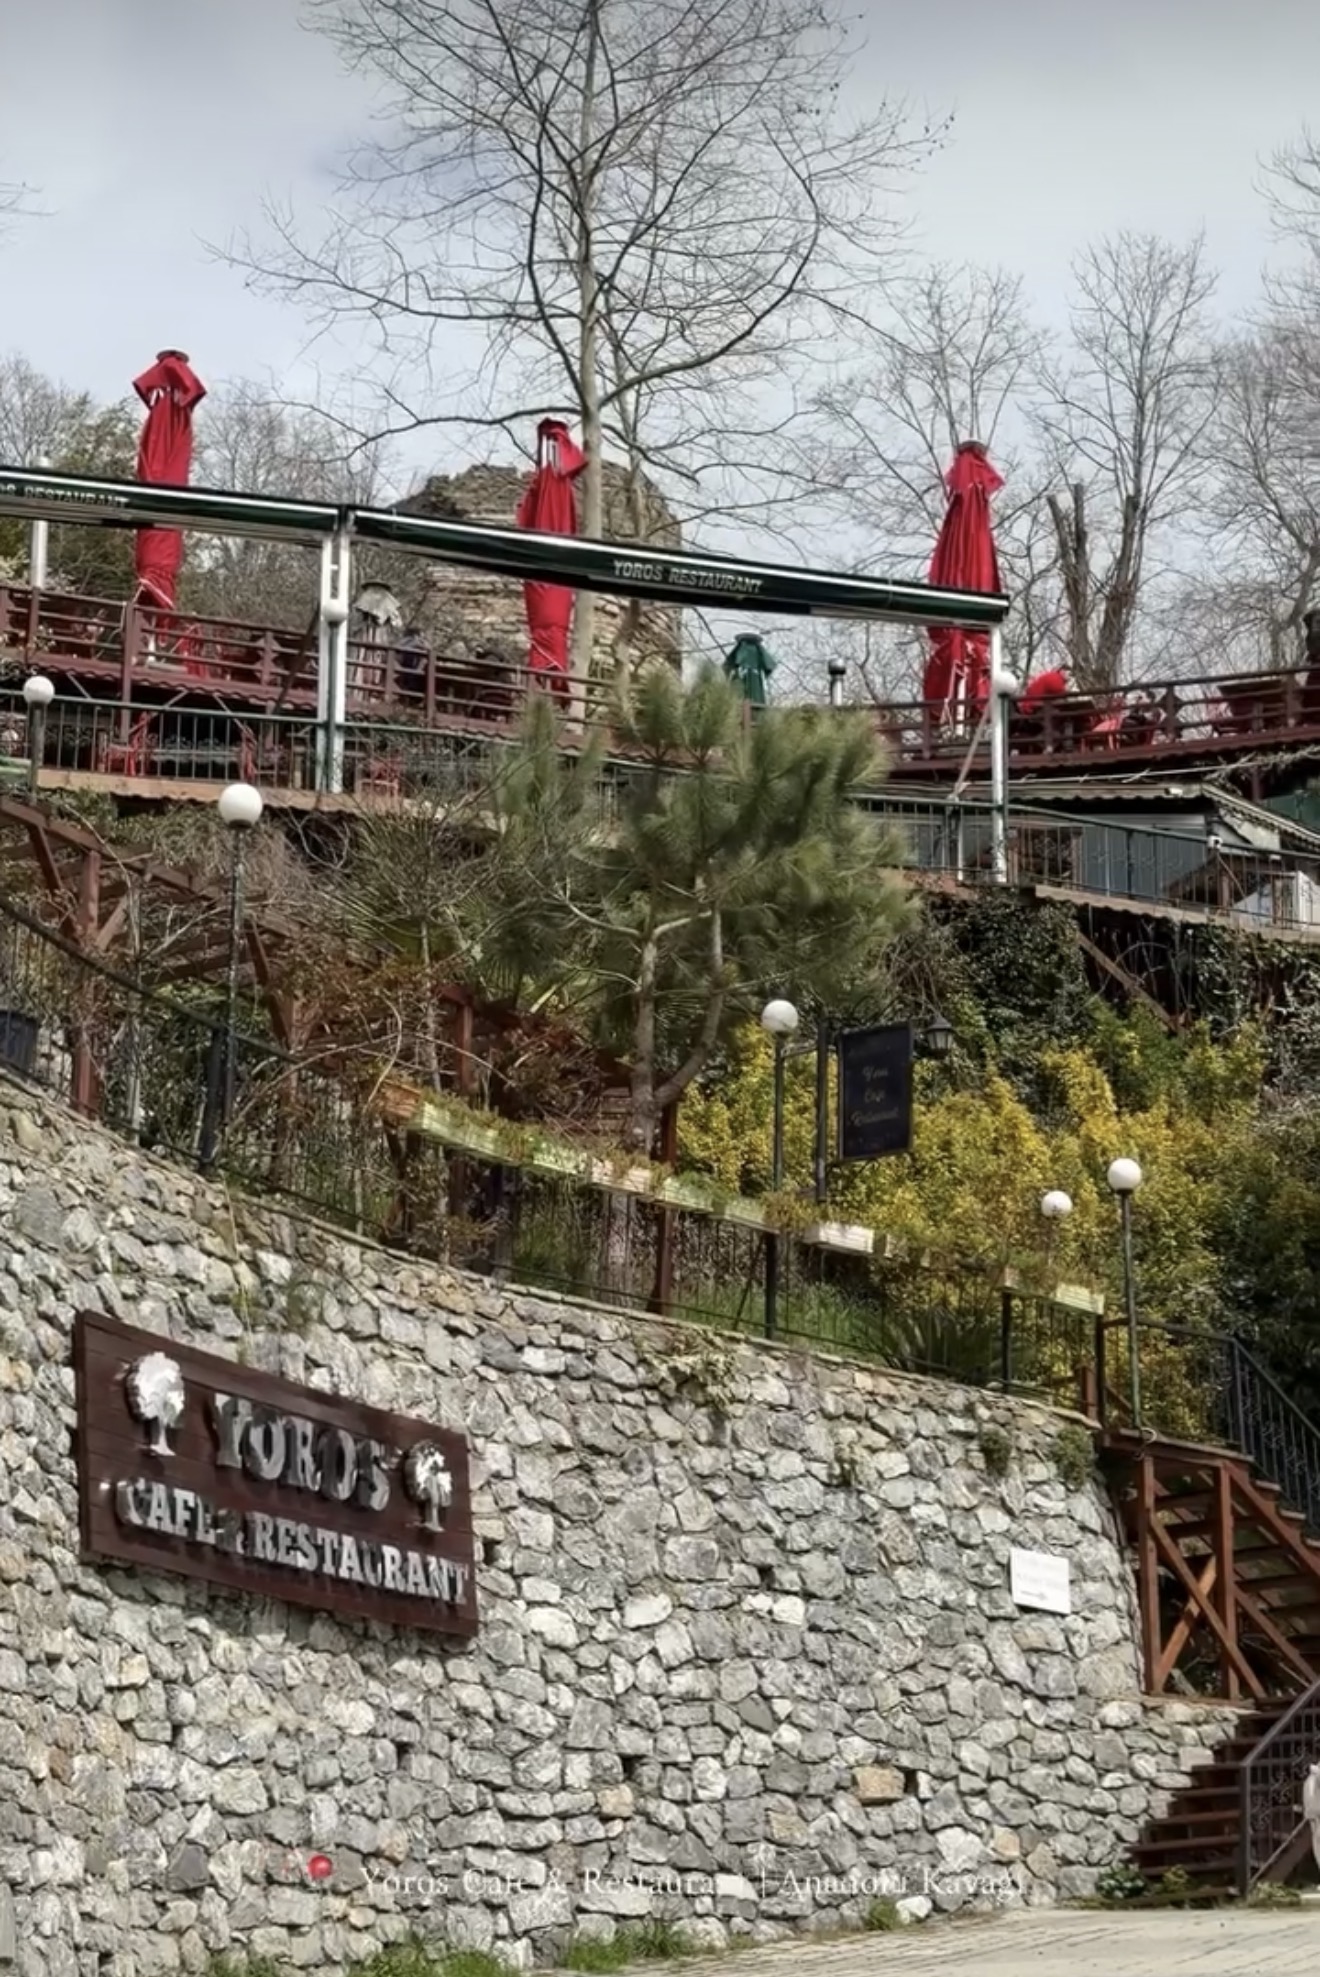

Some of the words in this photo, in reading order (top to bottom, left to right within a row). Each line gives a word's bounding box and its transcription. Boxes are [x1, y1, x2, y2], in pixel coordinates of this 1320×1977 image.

[24, 485, 130, 508] RESTAURANT
[613, 560, 664, 581] YOROS
[668, 568, 763, 593] RESTAURANT
[214, 1393, 390, 1511] YOROS
[115, 1478, 216, 1546] CAFE
[246, 1510, 469, 1606] RESTAURANT
